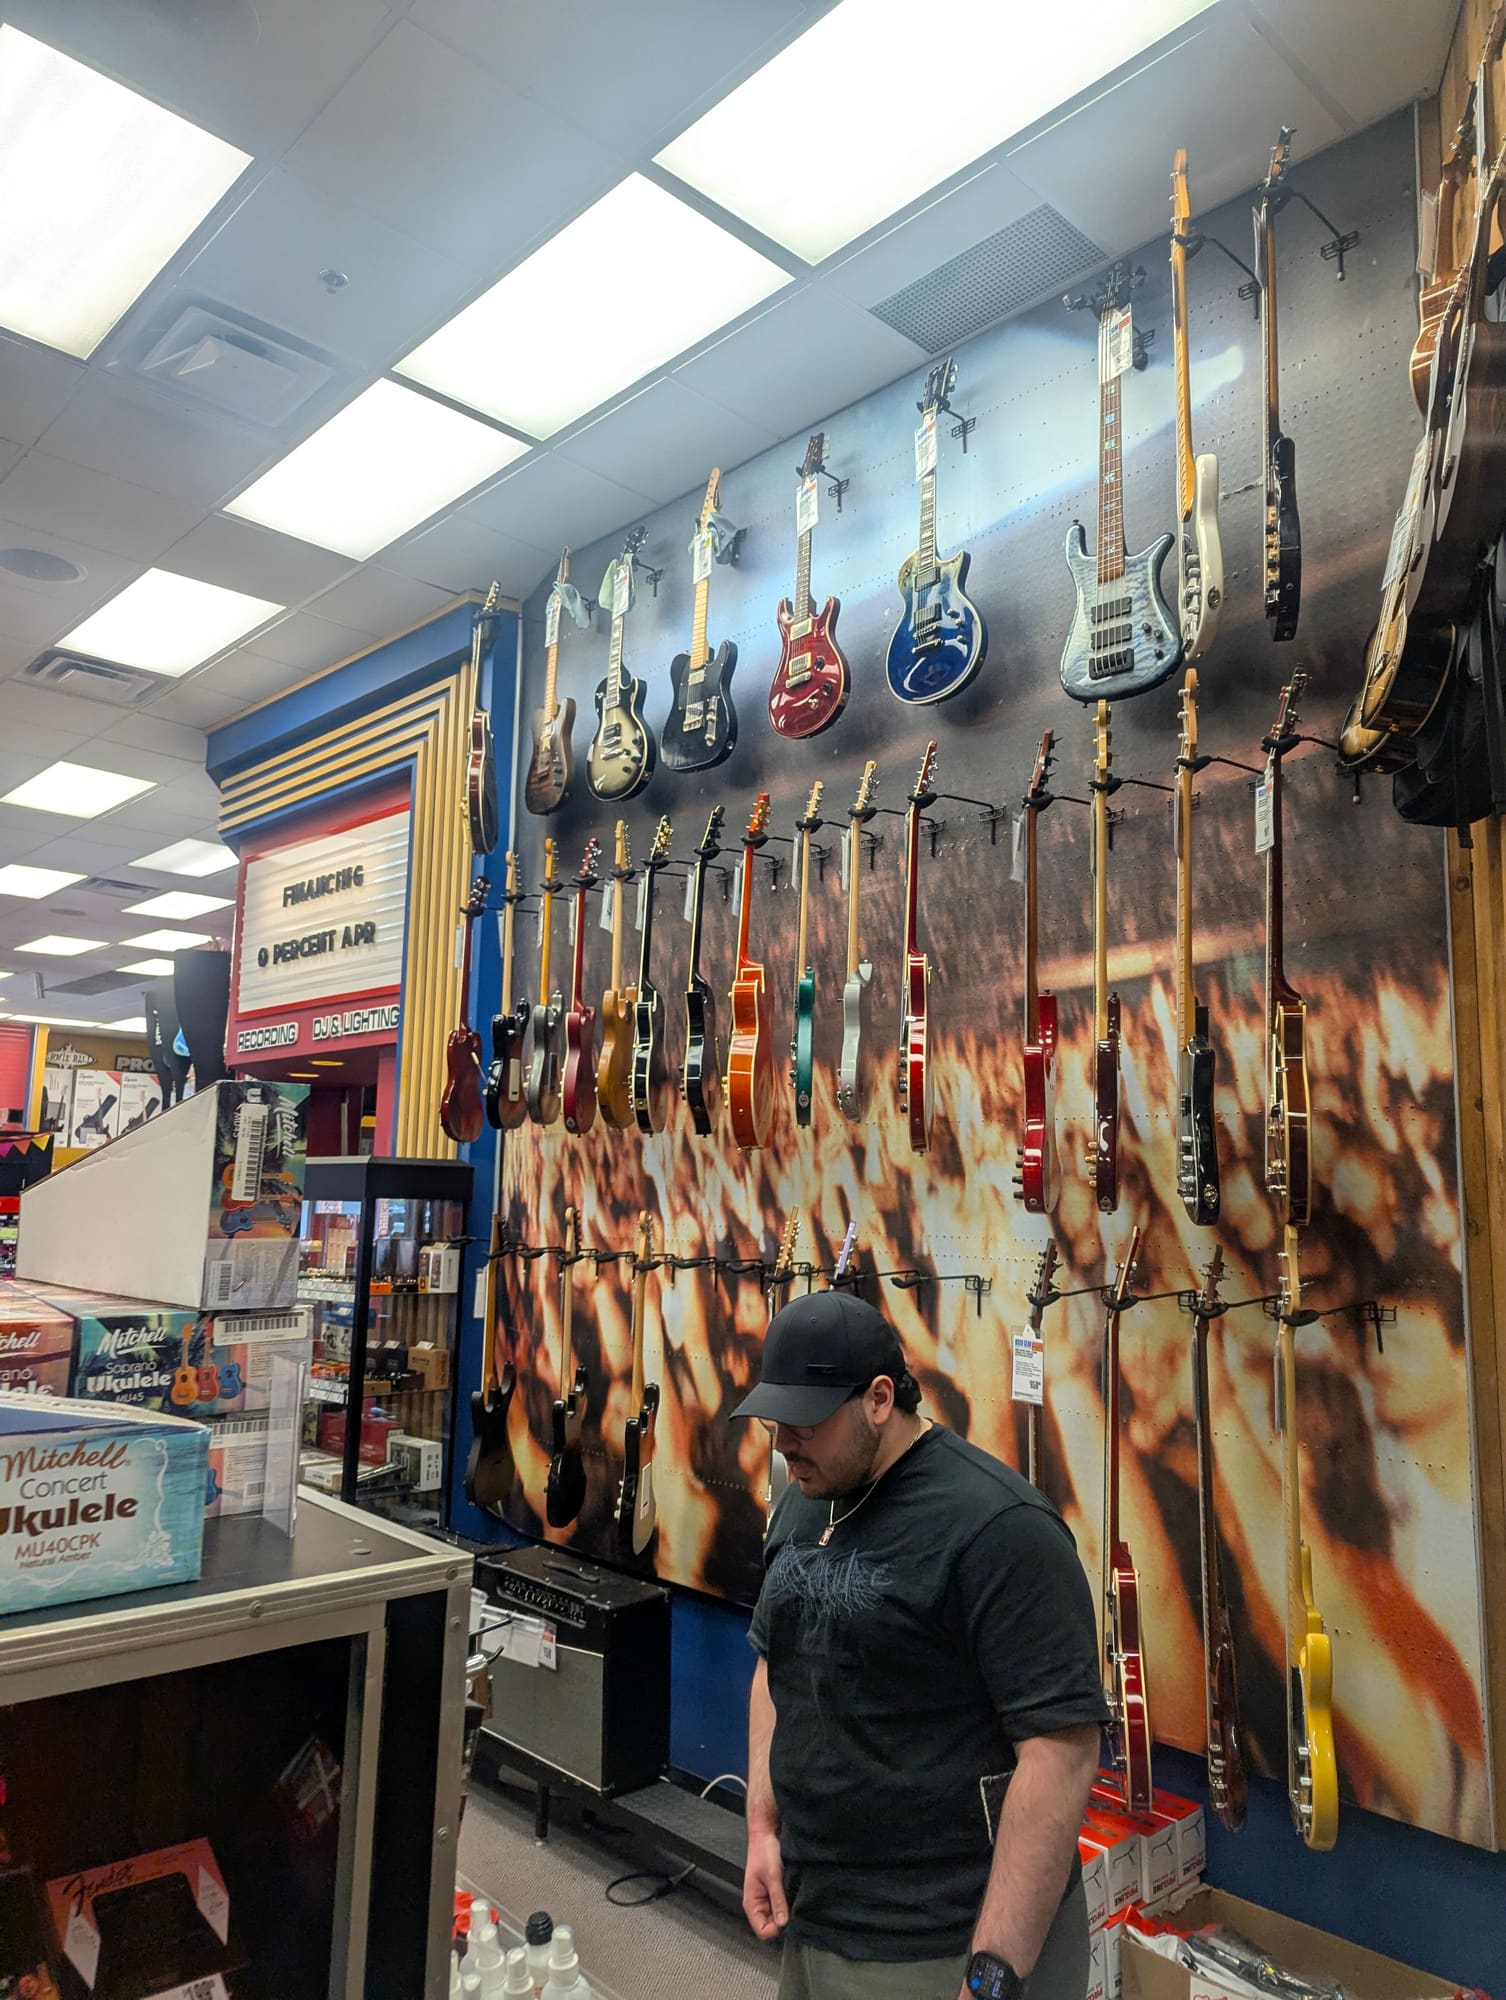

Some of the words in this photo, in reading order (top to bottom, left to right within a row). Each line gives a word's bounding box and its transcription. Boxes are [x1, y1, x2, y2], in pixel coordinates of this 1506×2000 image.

[282, 865, 364, 908] FINANCING
[273, 930, 337, 965] PERCENT
[341, 921, 376, 949] APR
[238, 1023, 297, 1050] RECORDING
[313, 1019, 328, 1039] DJ
[331, 1016, 340, 1035] &
[343, 1006, 400, 1033] LIGHTING
[274, 1095, 299, 1159] Mitchell
[96, 1326, 168, 1360] Mitchell
[87, 1371, 172, 1393] Ukulele
[104, 1361, 157, 1376] Soprano
[116, 1392, 145, 1402] MU45
[0, 1439, 129, 1482] Mitchell
[20, 1472, 108, 1500] Concert
[15, 1532, 102, 1560] MU40CPK
[1114, 1885, 1139, 1907] PROLINE
